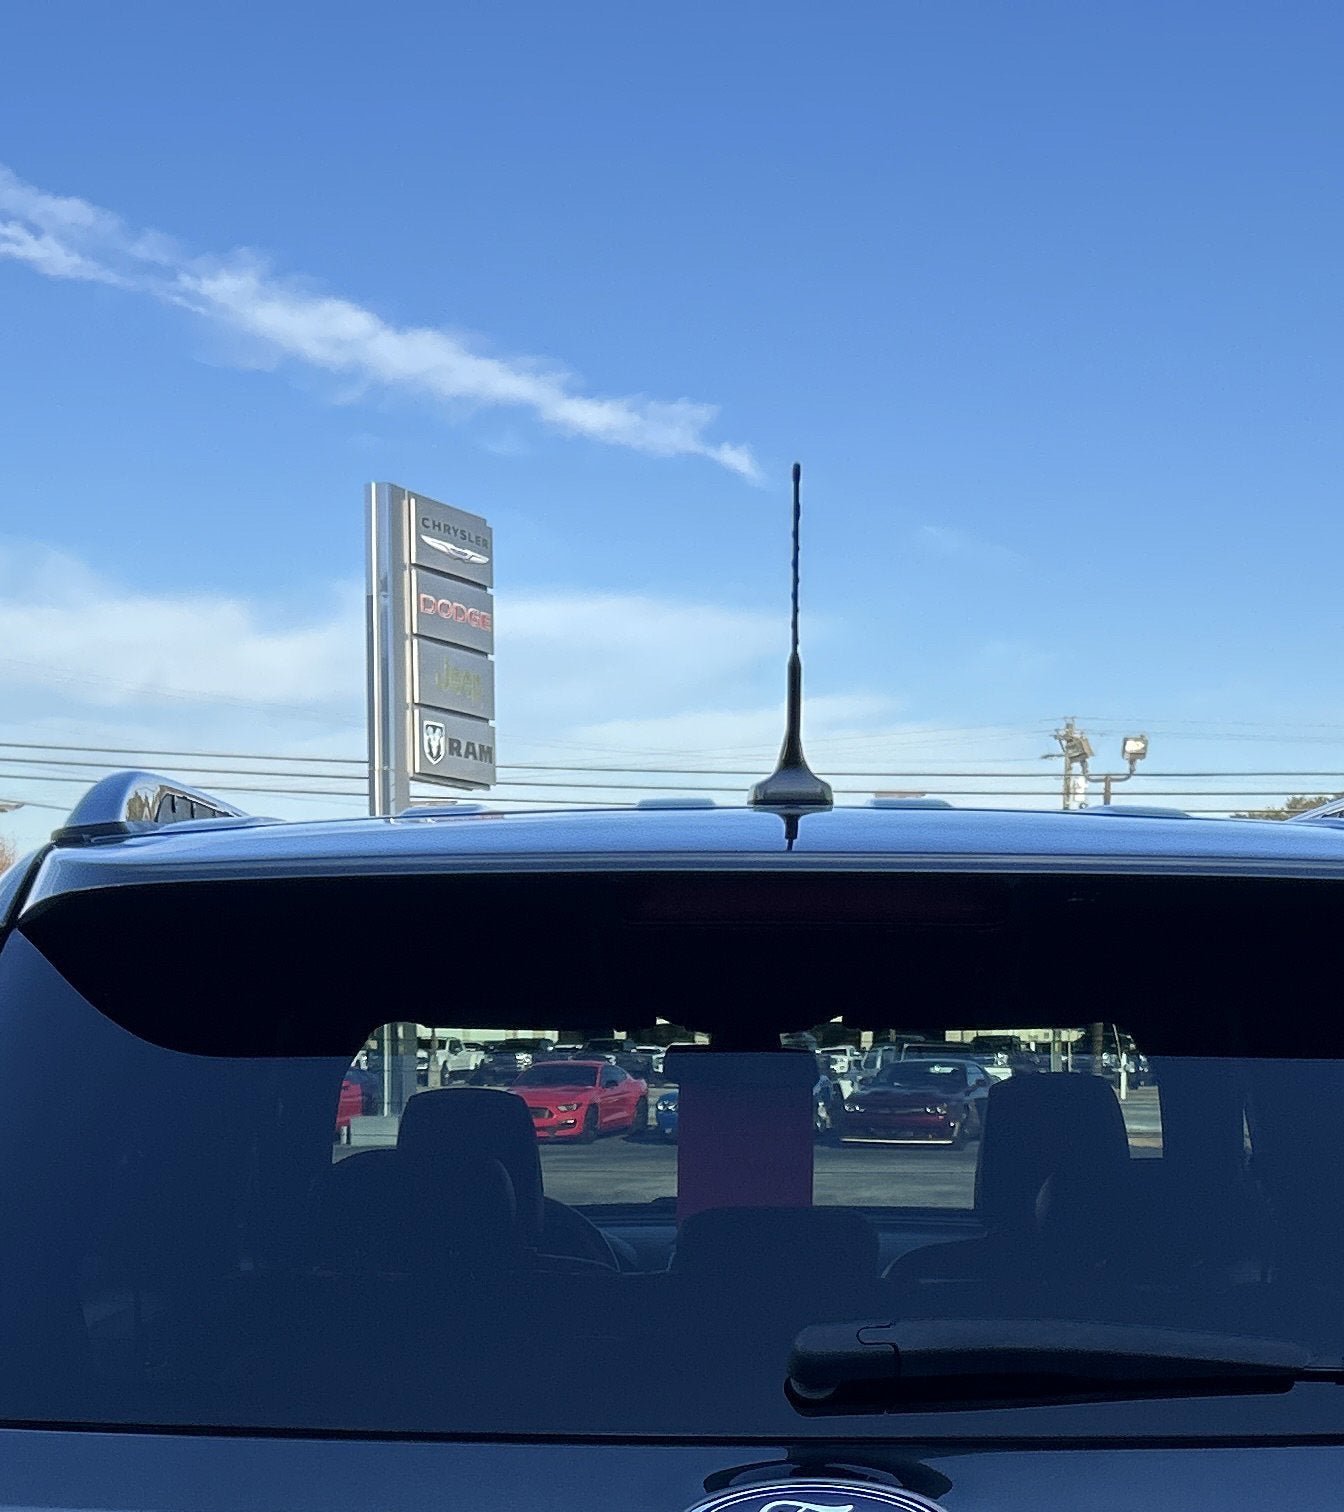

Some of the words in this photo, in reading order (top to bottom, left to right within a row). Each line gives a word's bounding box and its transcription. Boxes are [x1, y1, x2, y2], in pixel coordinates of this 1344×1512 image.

[421, 517, 489, 549] CHRYSLER
[420, 593, 491, 630] DODGE
[448, 737, 493, 765] RAM
